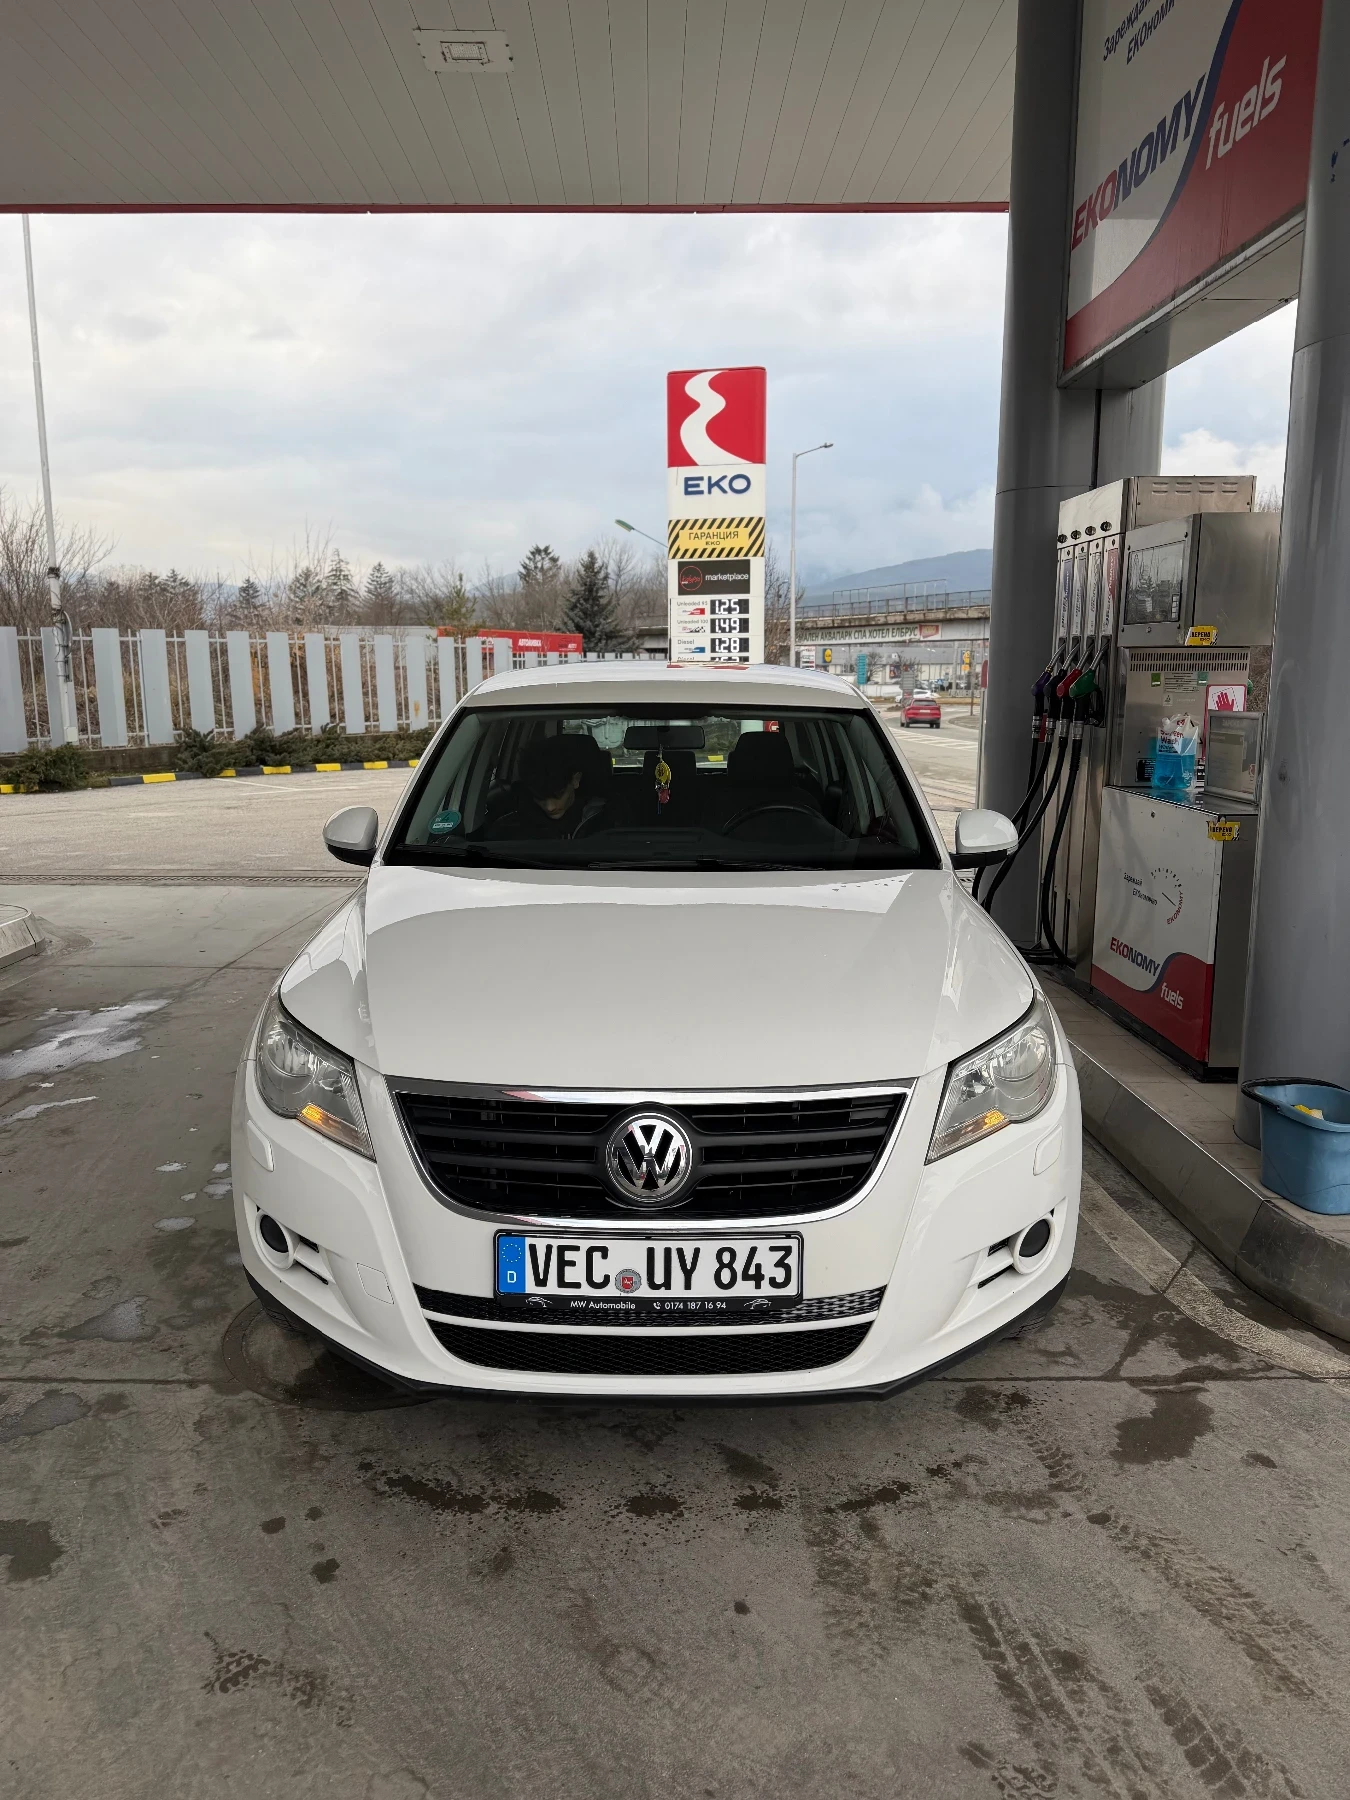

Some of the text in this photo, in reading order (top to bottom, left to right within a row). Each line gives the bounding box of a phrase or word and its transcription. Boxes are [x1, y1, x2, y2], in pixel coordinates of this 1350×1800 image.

[1103, 0, 1151, 61] Зарежда
[1205, 55, 1287, 170] fuels
[1071, 72, 1207, 251] EKONOMY
[684, 474, 752, 496] EKO
[688, 530, 739, 540] ГАРАНЦИЯ
[705, 573, 749, 581] marketplace
[715, 618, 740, 633] 1.49
[820, 630, 853, 641] АКВАПАРК
[853, 629, 867, 639] СПА
[868, 628, 890, 639] ХОТЕЛ
[891, 626, 918, 637] ЕЛБРУС
[1109, 936, 1161, 977] EKONOMY
[1160, 982, 1184, 1010] fuels
[507, 1270, 517, 1284] D
[528, 1243, 611, 1290] VEC
[646, 1246, 701, 1291] UY
[713, 1245, 793, 1291] 843
[588, 1301, 636, 1310] Automobile
[664, 1302, 684, 1310] 0174
[687, 1301, 701, 1309] 187
[705, 1301, 714, 1309] 16
[716, 1301, 727, 1309] 94
